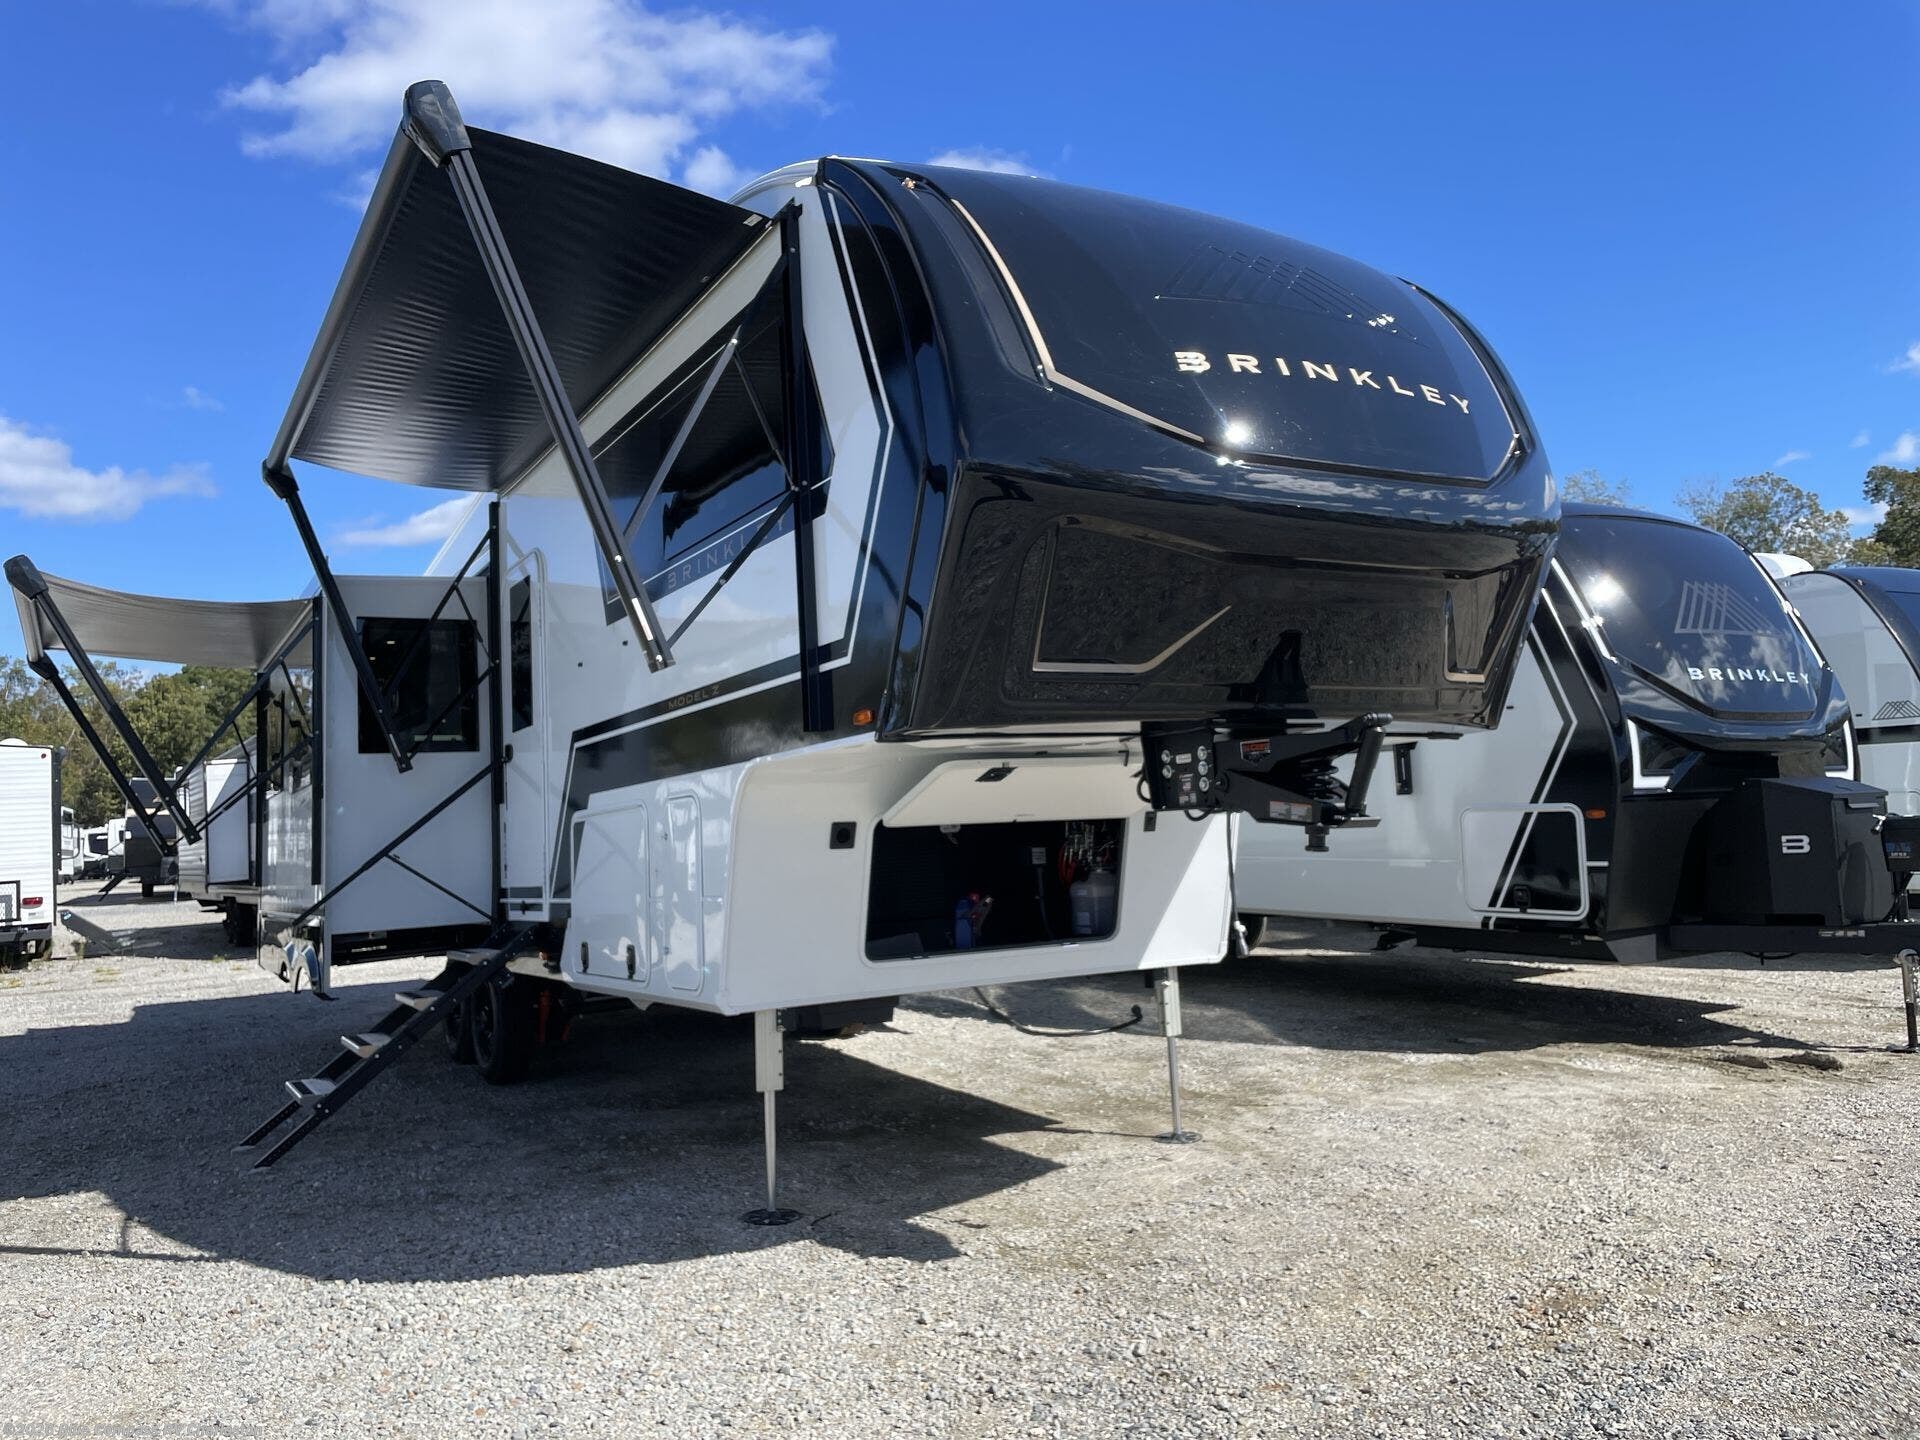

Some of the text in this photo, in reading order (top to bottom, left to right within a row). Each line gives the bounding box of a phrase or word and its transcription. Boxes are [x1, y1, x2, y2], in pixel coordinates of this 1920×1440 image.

[1174, 351, 1472, 415] BRINKLEY
[1688, 667, 1810, 685] BRINKLEY
[667, 690, 709, 710] MODEL
